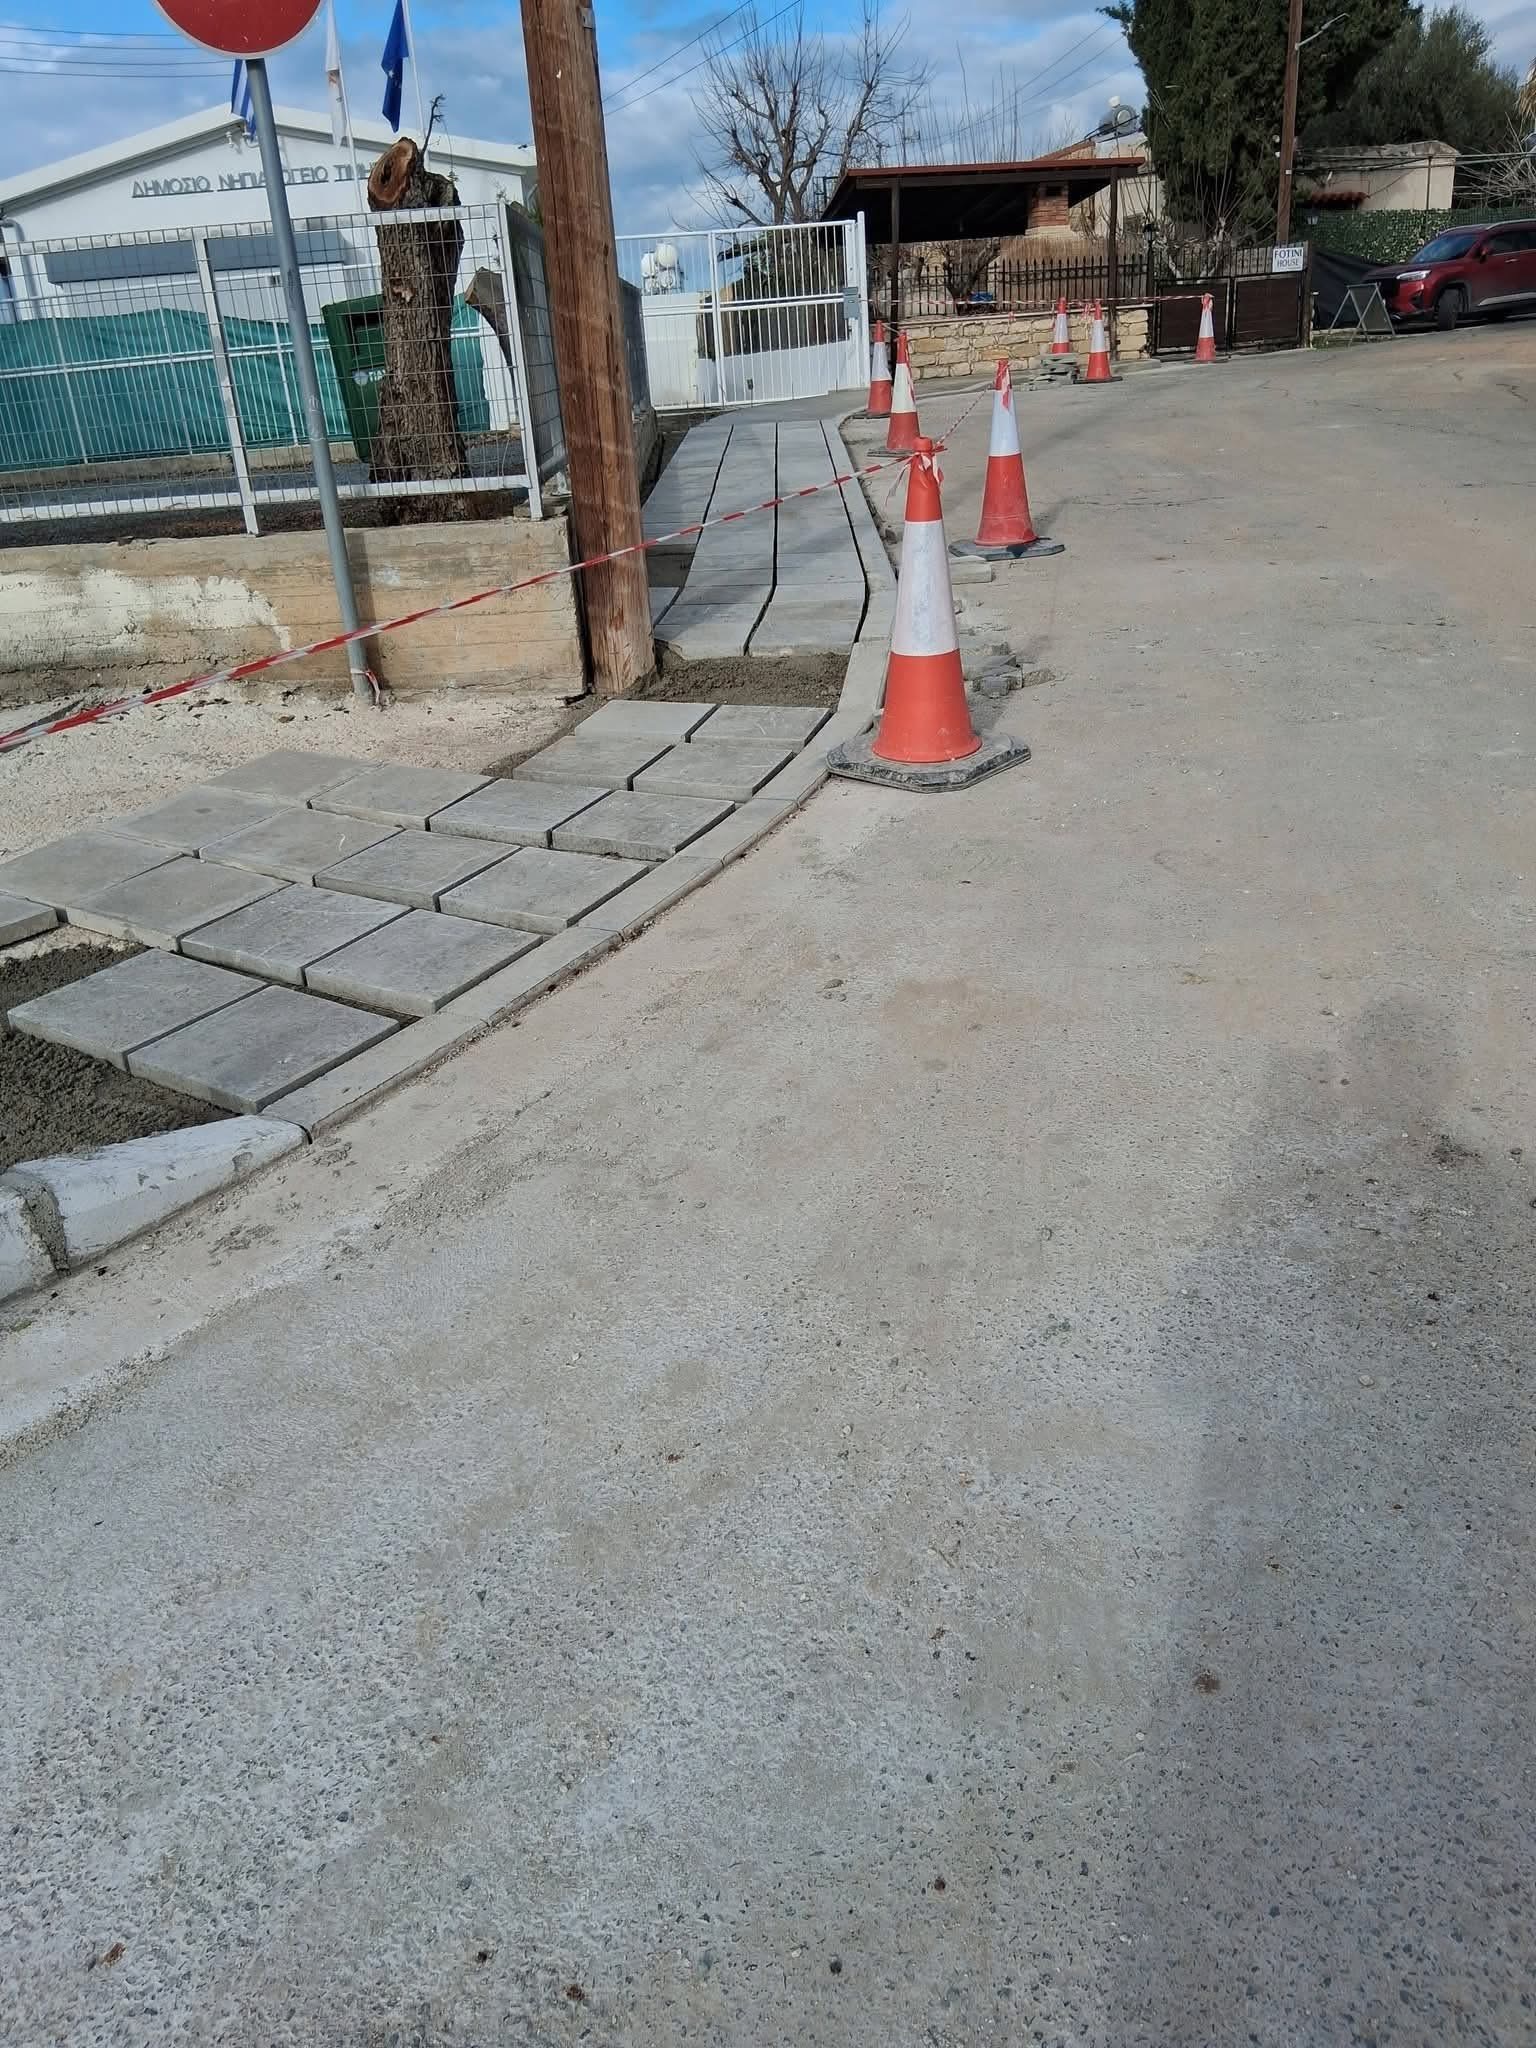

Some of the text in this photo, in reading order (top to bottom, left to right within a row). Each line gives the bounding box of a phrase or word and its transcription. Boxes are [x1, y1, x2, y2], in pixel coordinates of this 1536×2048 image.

[132, 175, 212, 197] ΔΗΜΟΣΙΟ
[1274, 249, 1302, 259] FOTINI
[1277, 257, 1299, 267] HOUSE
